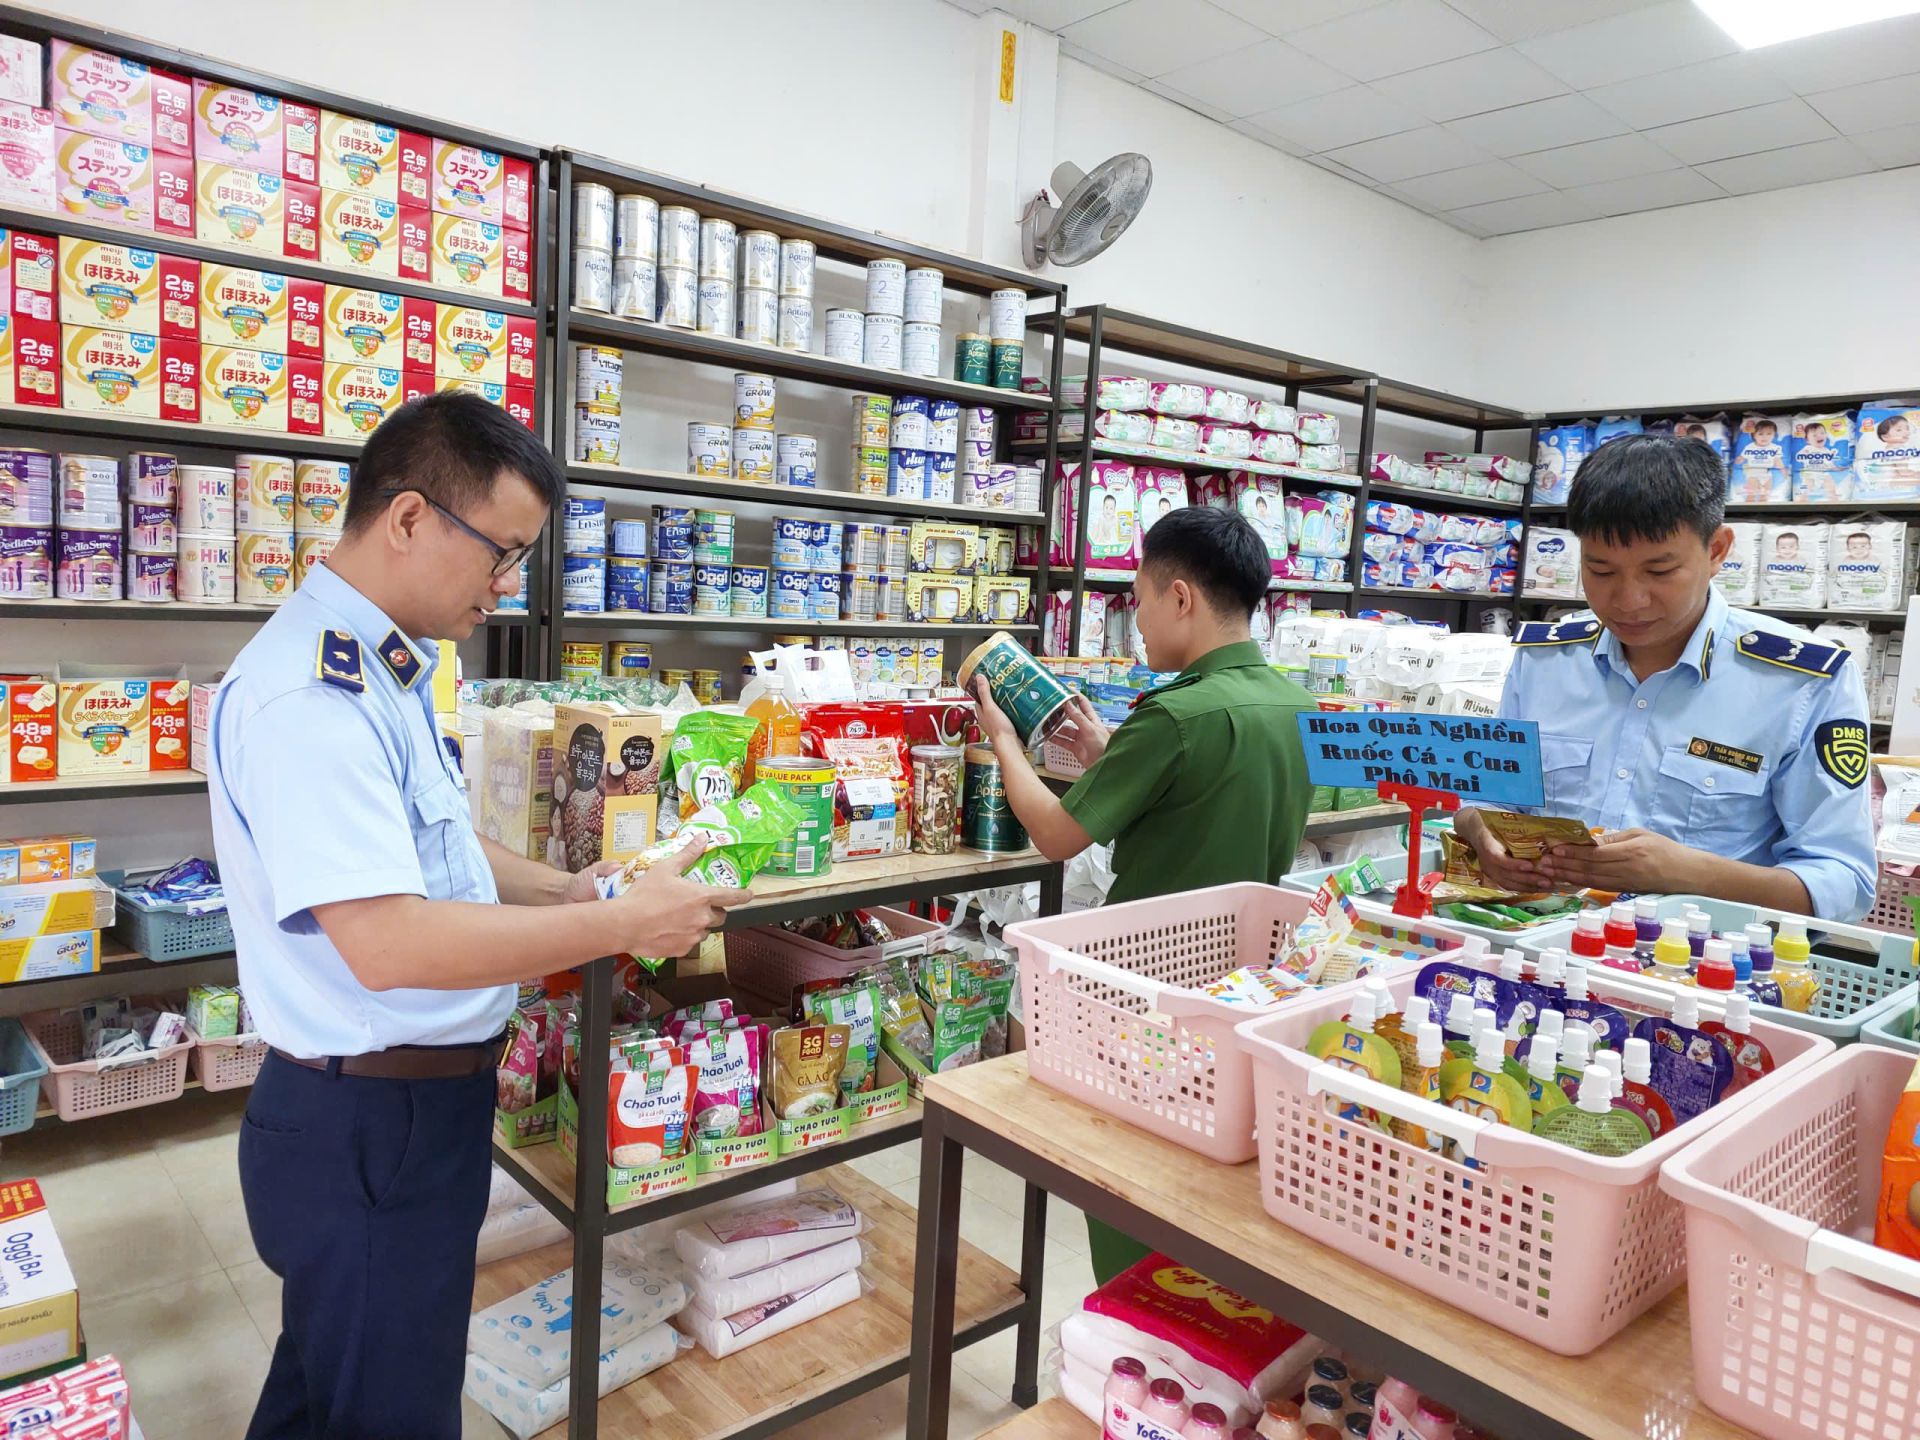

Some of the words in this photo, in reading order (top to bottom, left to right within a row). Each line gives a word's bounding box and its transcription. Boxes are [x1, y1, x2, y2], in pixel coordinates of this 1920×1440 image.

[76, 68, 130, 92] ステップ
[215, 102, 264, 123] ステップ
[339, 135, 383, 156] ほほえみ
[78, 156, 132, 177] ステップ
[450, 161, 488, 180] ステップ
[217, 185, 267, 207] ほほえみ
[340, 212, 383, 232] ほほえみ
[100, 246, 123, 256] meiji
[450, 235, 489, 254] ほほえみ
[84, 263, 140, 284] ほほえみ
[878, 280, 887, 293] 2
[221, 287, 271, 306] ほほえみ
[343, 308, 388, 326] ほほえみ
[1006, 309, 1014, 321] 2
[453, 326, 493, 342] ほほえみ
[881, 335, 890, 348] 2
[86, 349, 141, 368] ほほえみ
[221, 368, 271, 386] ほほえみ
[343, 384, 388, 400] ほほえみ
[1744, 447, 1778, 457] moony
[1797, 452, 1836, 460] moony
[302, 482, 342, 495] ほほえみ
[252, 552, 291, 565] ほほえみ
[1767, 562, 1807, 572] moony
[1838, 564, 1881, 573] moony
[696, 570, 728, 585] Oggi
[733, 570, 763, 586] Oggi
[990, 654, 1027, 690] Aptamil
[84, 699, 132, 710] ほほえみ
[74, 711, 138, 721] らくらくキューブ
[160, 727, 176, 735] 入り
[1307, 717, 1360, 734] Hoa
[1368, 717, 1423, 737] Quả
[1429, 720, 1528, 744] Nghiền
[1832, 727, 1865, 740] DMS
[22, 734, 43, 744] 入り
[1319, 740, 1394, 762] Ruốc
[1401, 744, 1438, 765] Cá
[1463, 750, 1522, 774] Cua
[765, 771, 788, 780] VALUE
[1362, 765, 1419, 787] Phô
[1426, 770, 1482, 793] Mai
[56, 939, 88, 956] GROW
[803, 1036, 821, 1048] SG
[802, 1047, 821, 1055] FOOD
[867, 1105, 873, 1117] 1
[802, 1132, 809, 1146] 1
[724, 1153, 732, 1166] 1
[641, 1181, 649, 1195] 1
